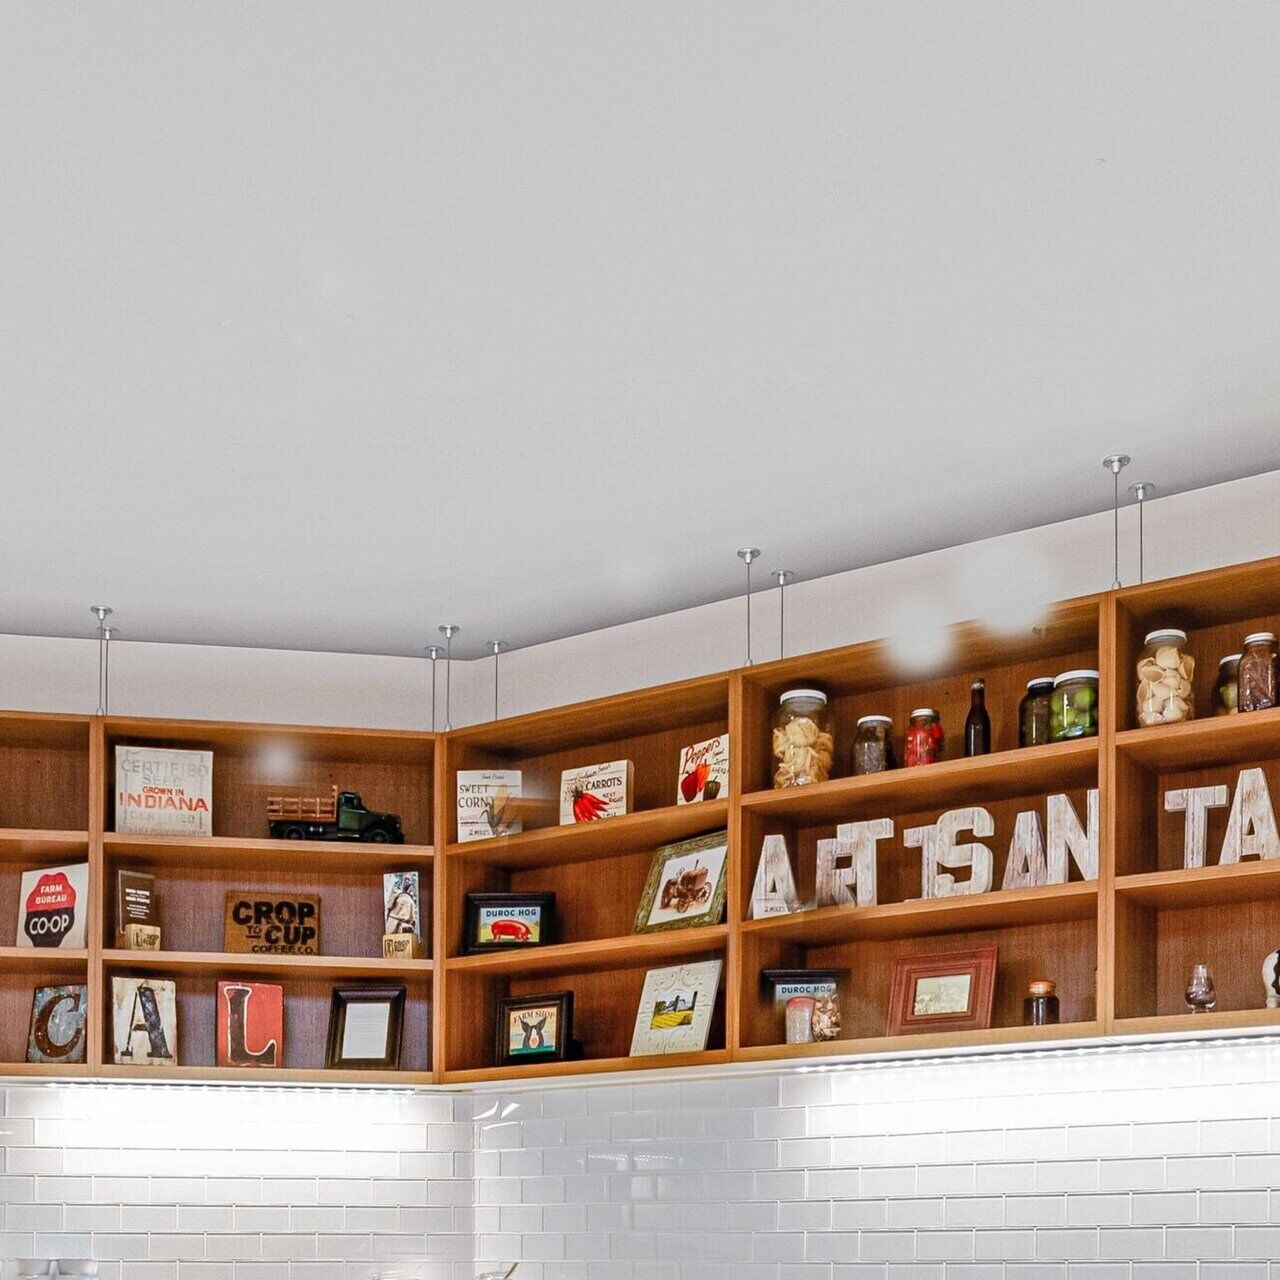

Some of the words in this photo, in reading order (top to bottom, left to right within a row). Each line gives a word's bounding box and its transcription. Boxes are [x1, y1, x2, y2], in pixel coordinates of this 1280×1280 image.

[682, 739, 720, 774] Peppers
[121, 759, 209, 777] CERTIFIED
[459, 784, 489, 794] SWEET
[586, 777, 622, 790] CARROTS
[142, 786, 173, 795] GROWN
[175, 788, 184, 796] IN
[120, 792, 209, 811] INDIANA
[458, 796, 488, 808] CORN
[40, 884, 63, 893] FARM
[35, 894, 67, 904] BUREAU
[233, 900, 316, 925] CROP
[486, 909, 515, 917] DUROC
[246, 926, 261, 935] TO
[264, 925, 316, 945] CUP
[252, 945, 294, 954] COFFEE
[781, 986, 811, 994] DUROC
[513, 1011, 533, 1023] FARM
